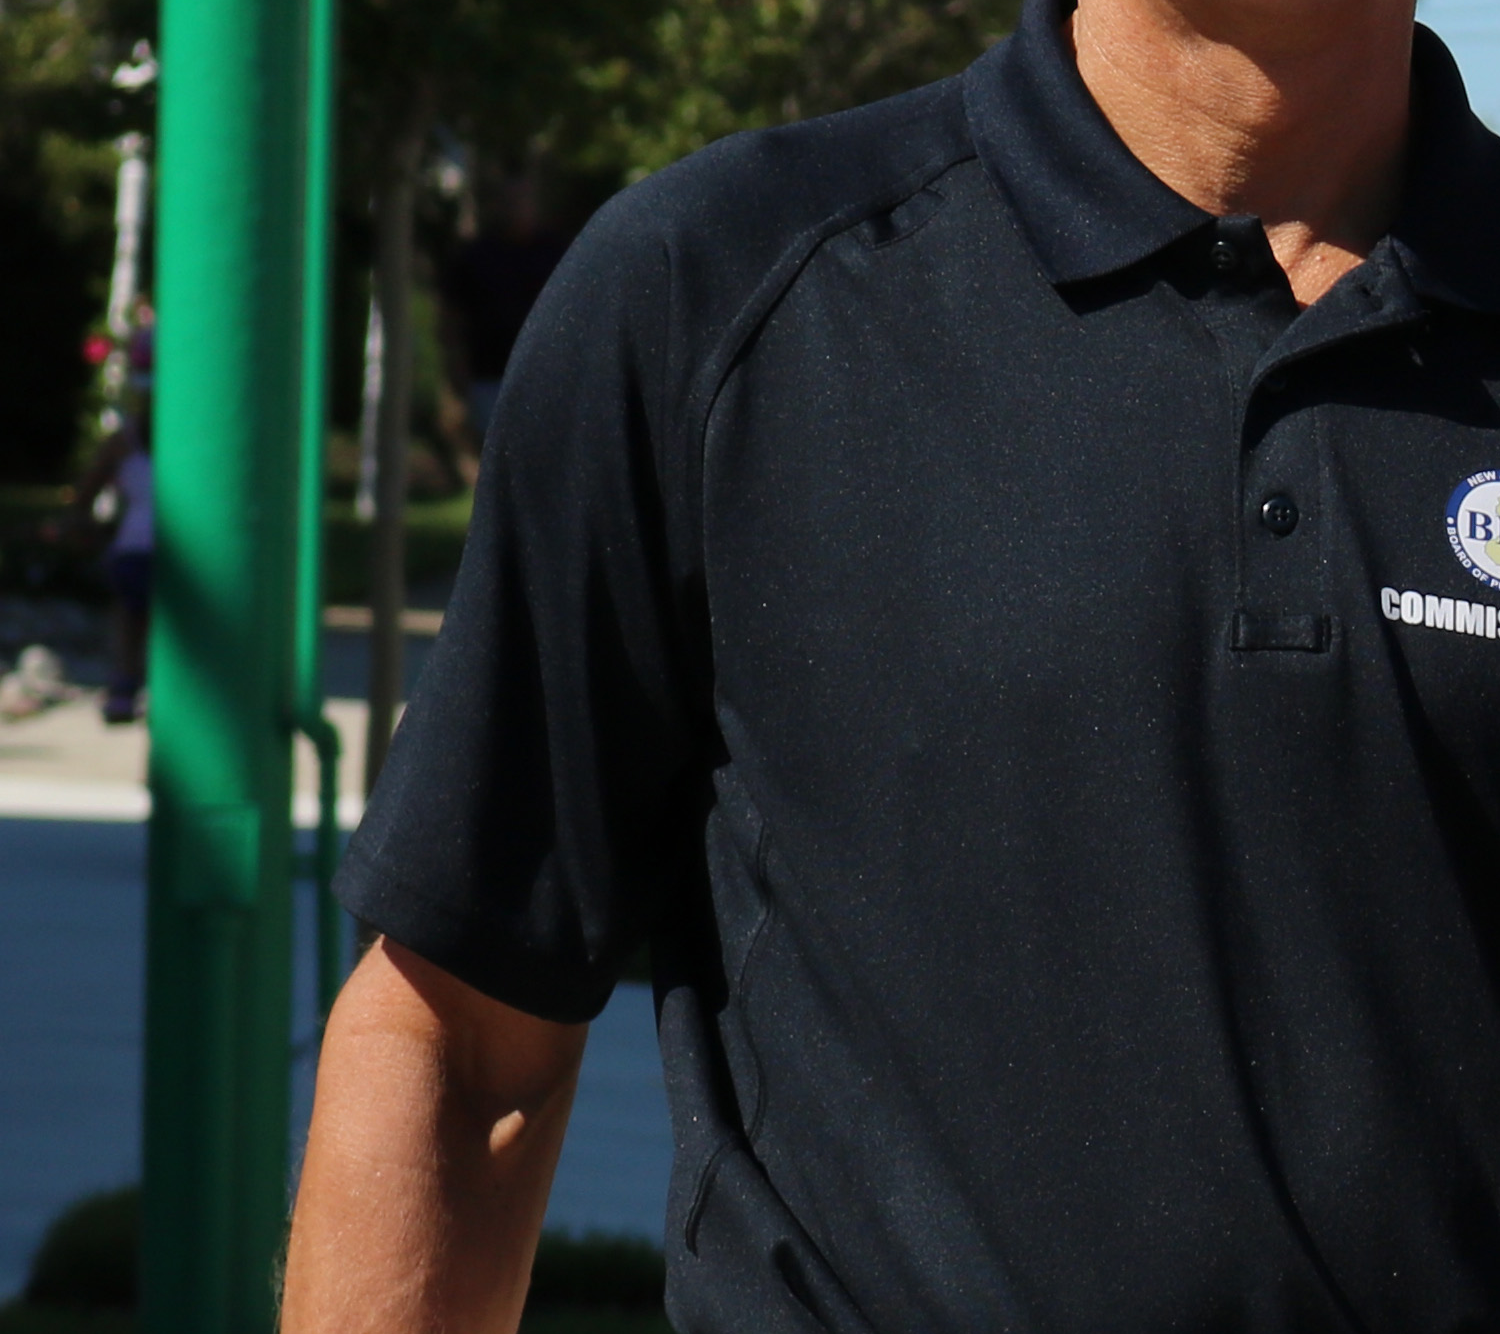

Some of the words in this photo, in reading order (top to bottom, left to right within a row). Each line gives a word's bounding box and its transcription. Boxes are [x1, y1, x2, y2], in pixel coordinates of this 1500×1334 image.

[1467, 470, 1496, 487] NEW
[1446, 526, 1473, 569] BOARD
[1472, 567, 1489, 582] OF
